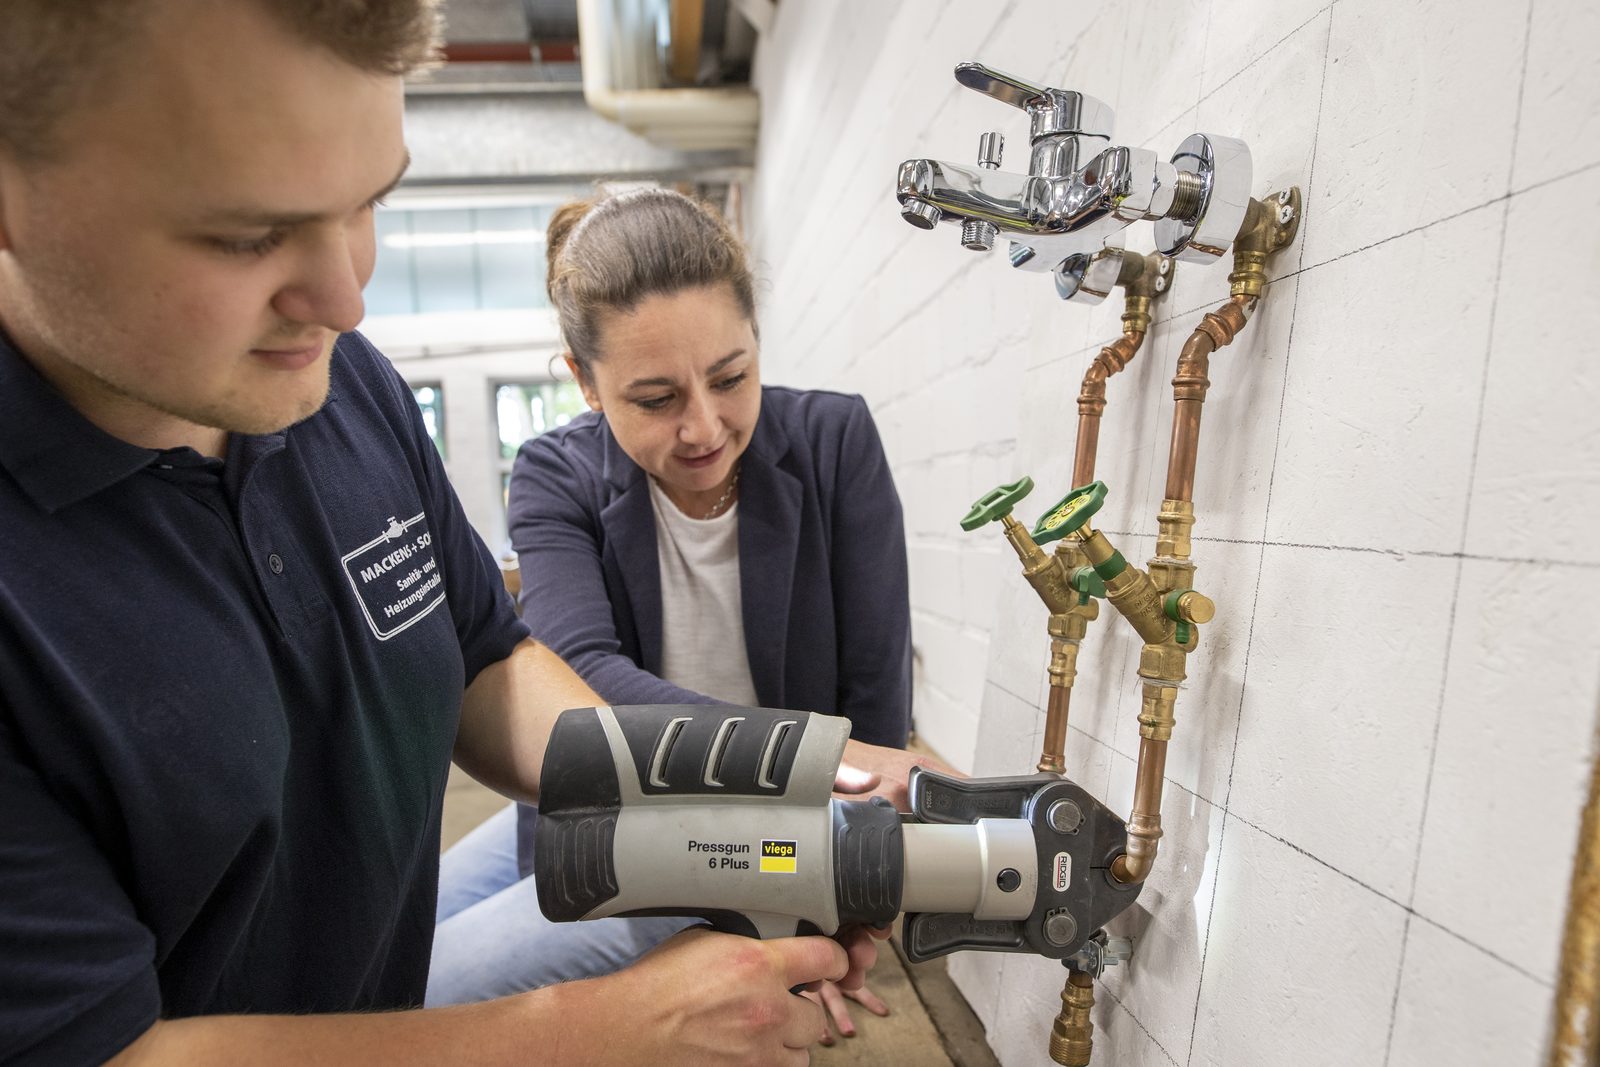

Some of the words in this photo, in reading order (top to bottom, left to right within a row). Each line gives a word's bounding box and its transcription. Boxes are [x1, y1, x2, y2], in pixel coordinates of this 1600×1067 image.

[360, 545, 412, 583] MACKENS
[411, 543, 418, 553] +
[416, 531, 431, 550] SO
[422, 557, 436, 574] und
[688, 840, 750, 855] Pressgun
[764, 842, 793, 856] viega
[708, 857, 717, 869] 6
[721, 858, 750, 869] Plus
[1059, 856, 1068, 888] RIDGID
